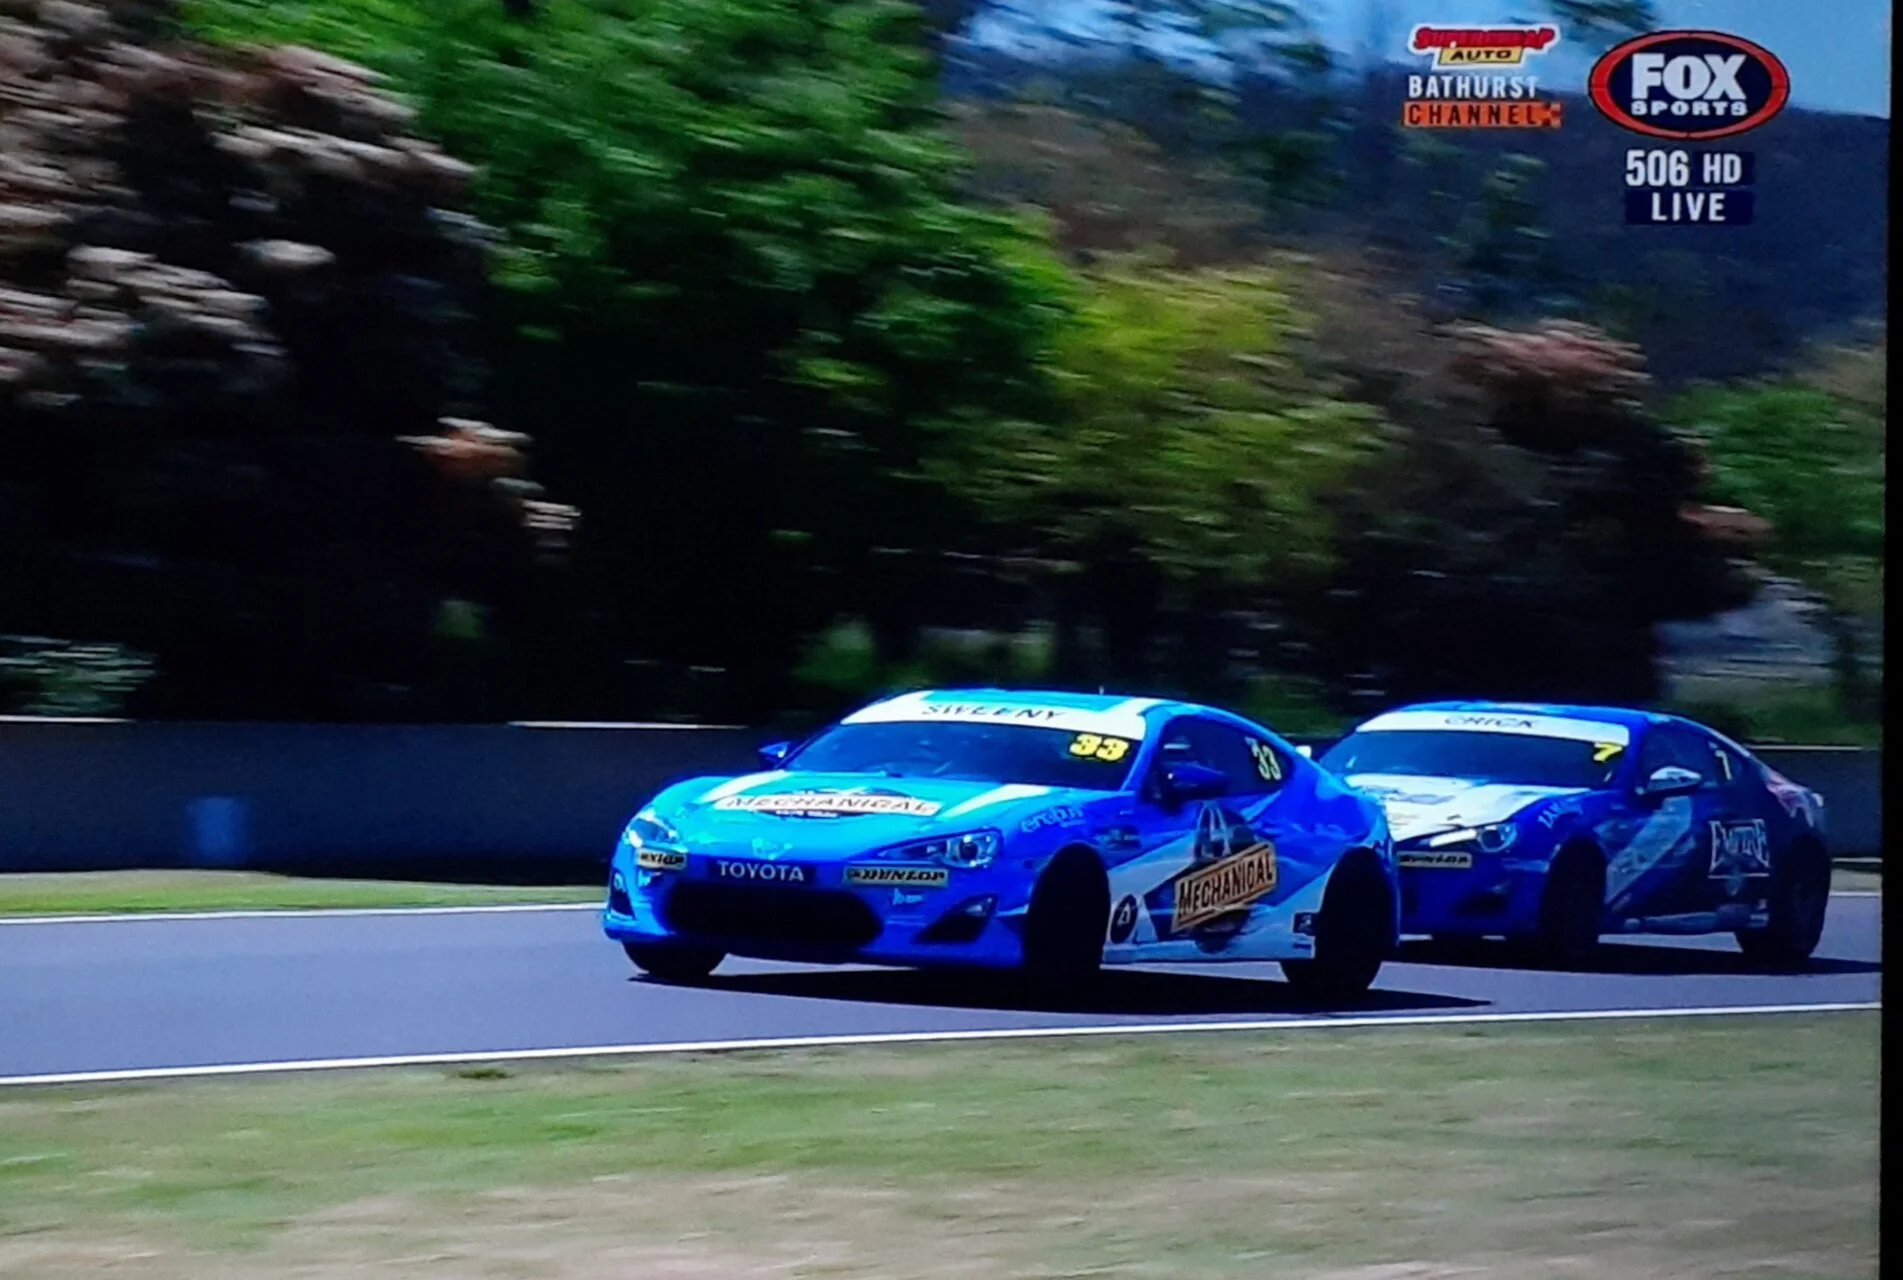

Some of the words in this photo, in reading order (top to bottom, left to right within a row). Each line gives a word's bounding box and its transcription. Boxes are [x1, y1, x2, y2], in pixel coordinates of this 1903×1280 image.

[1450, 50, 1512, 62] AUTO
[1408, 75, 1539, 99] BATHURST
[1631, 53, 1748, 100] FOX
[1408, 104, 1537, 125] CHANNEL
[1630, 100, 1749, 116] SPORTS
[1625, 149, 1690, 187] 506
[1702, 153, 1742, 184] HD
[1651, 192, 1727, 221] LIVE
[921, 704, 1067, 721] SWEENY
[1069, 732, 1130, 763] 33
[1244, 736, 1283, 780] 33
[1593, 741, 1624, 763] 7
[717, 859, 805, 882] TOYOTA
[1178, 851, 1275, 918] MECHANICAL
